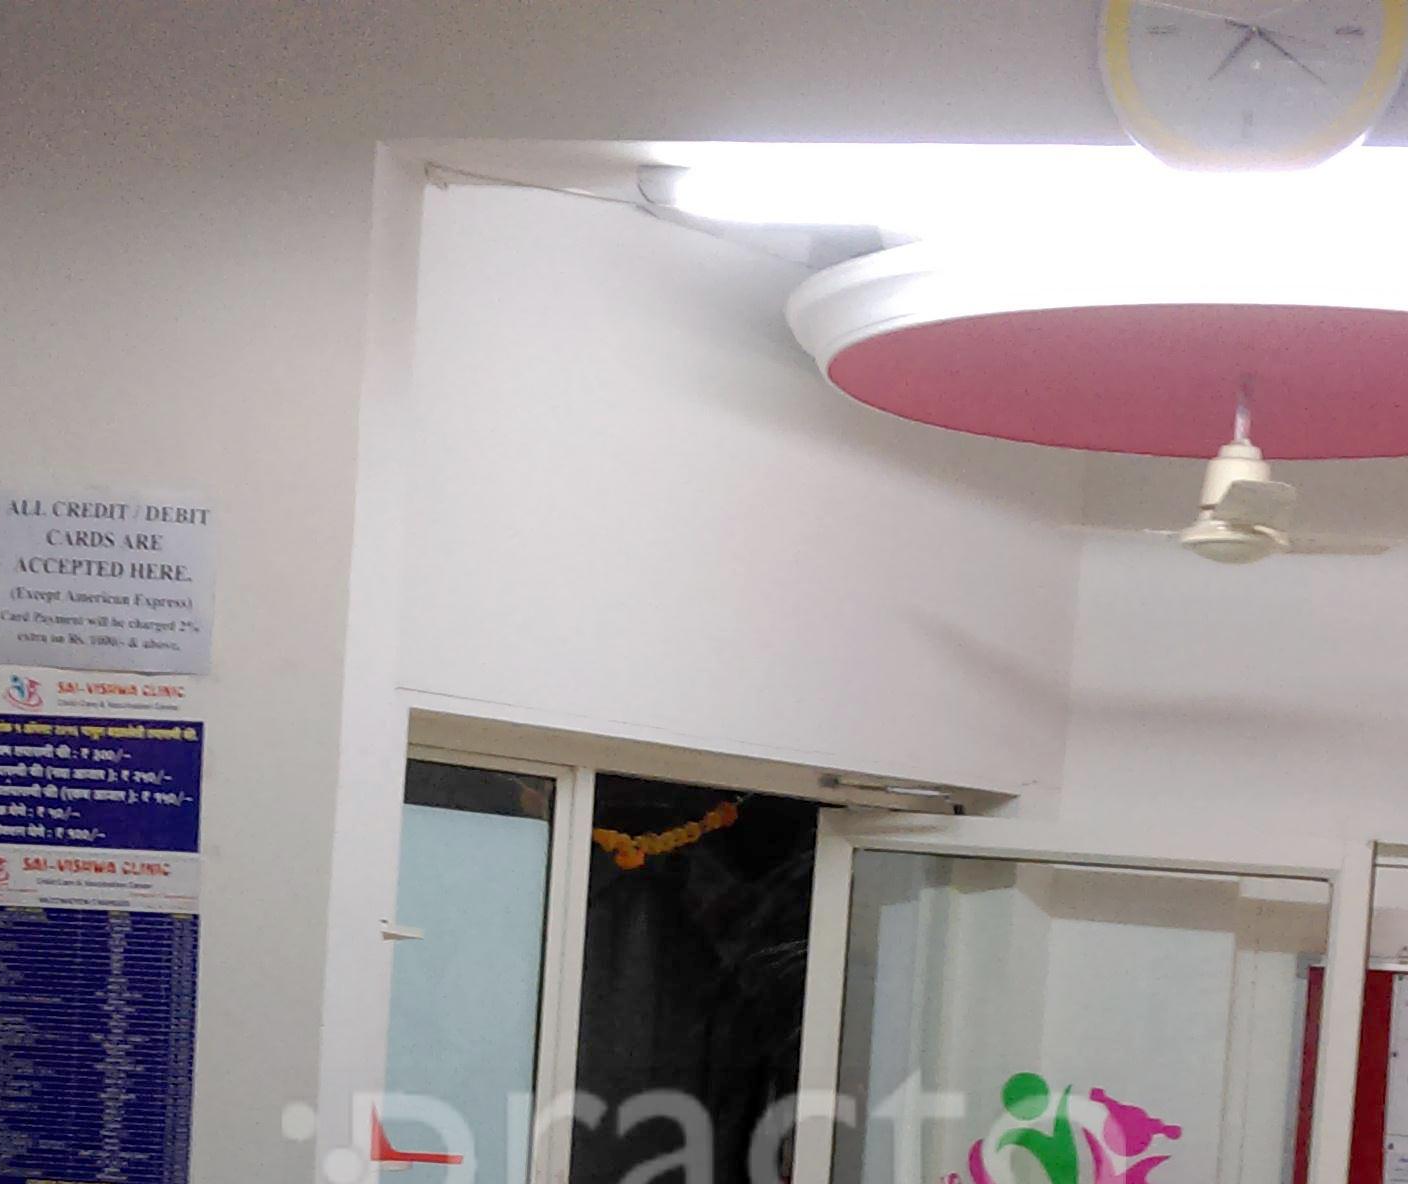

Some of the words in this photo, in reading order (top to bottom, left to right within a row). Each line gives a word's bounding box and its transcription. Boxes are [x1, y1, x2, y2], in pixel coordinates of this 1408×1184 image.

[9, 499, 45, 516] ALL
[52, 500, 129, 521] CREDIT
[145, 504, 210, 526] DEBIT
[46, 528, 115, 548] CARDS
[124, 533, 164, 551] ARE
[15, 556, 124, 578] ACCEPTED
[130, 562, 194, 582] HERE.
[68, 590, 130, 605] American
